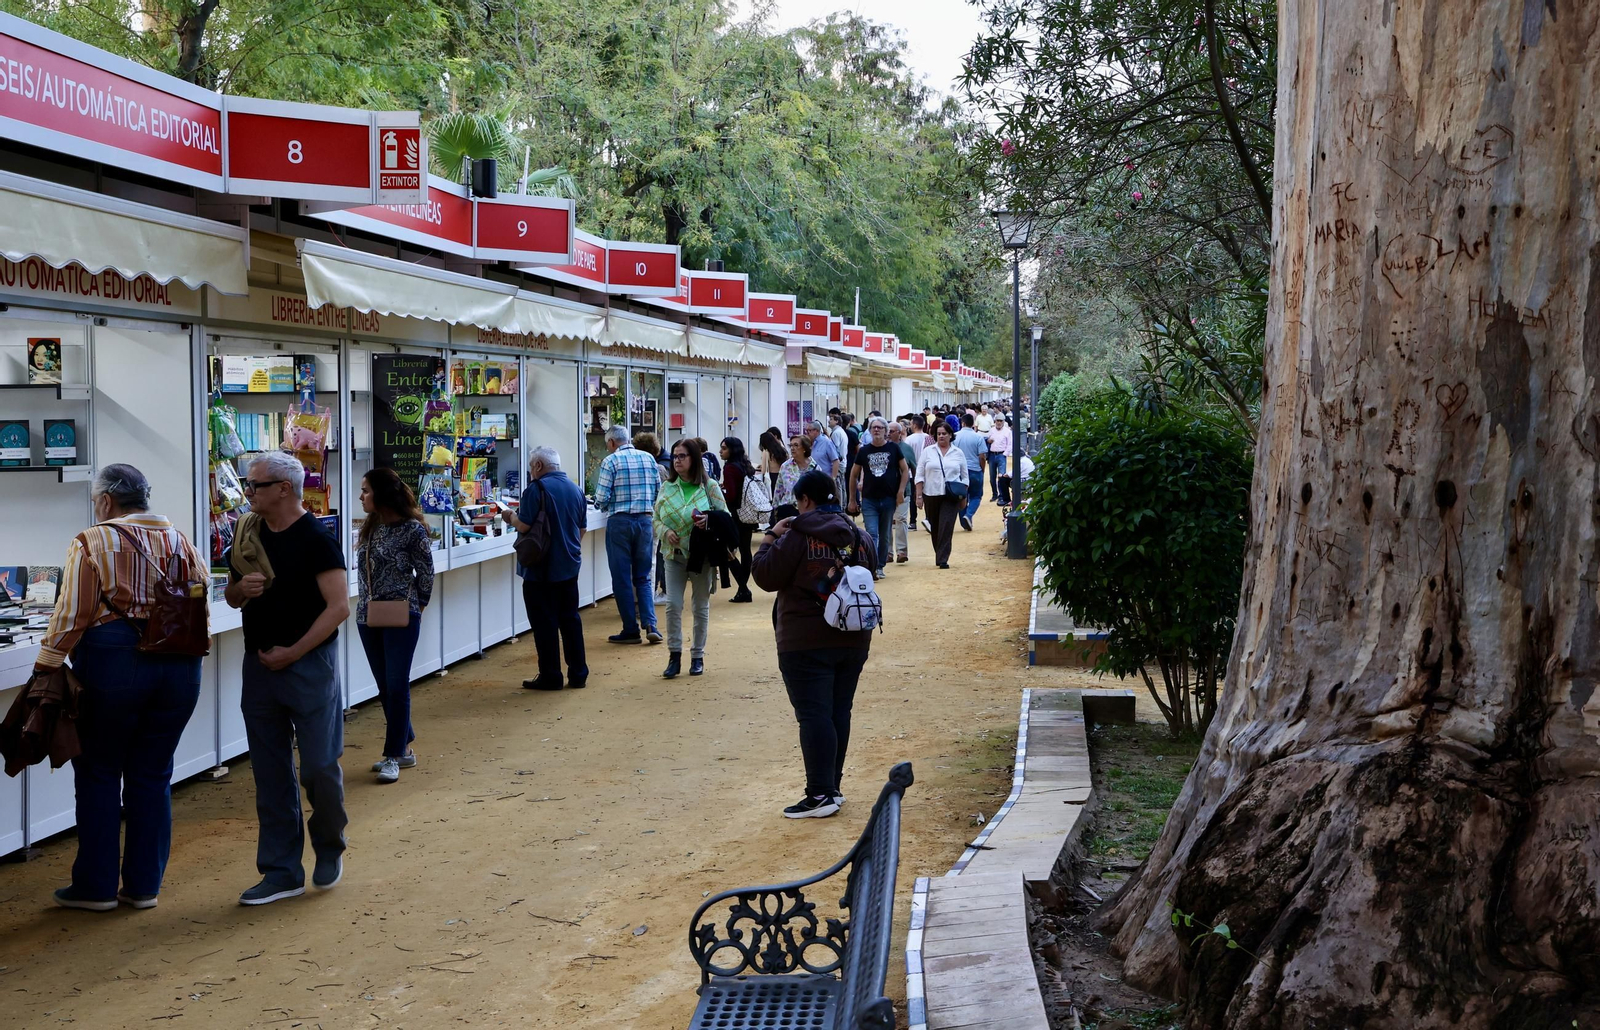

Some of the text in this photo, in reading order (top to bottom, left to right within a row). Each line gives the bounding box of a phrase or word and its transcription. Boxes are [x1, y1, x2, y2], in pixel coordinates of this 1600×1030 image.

[151, 108, 220, 155] EDITORIAL
[287, 140, 303, 164] 8
[381, 175, 418, 187] EXTINTOR
[517, 220, 528, 238] 9
[635, 262, 647, 276] 10
[103, 270, 172, 306] EDITORIAL
[713, 288, 721, 300] 11
[317, 304, 346, 329] ENTRE
[766, 307, 774, 318] 12
[804, 321, 811, 330] 13
[844, 334, 850, 342] 14
[392, 358, 428, 368] Librería
[386, 371, 435, 387] Entre
[383, 430, 423, 446] Líne
